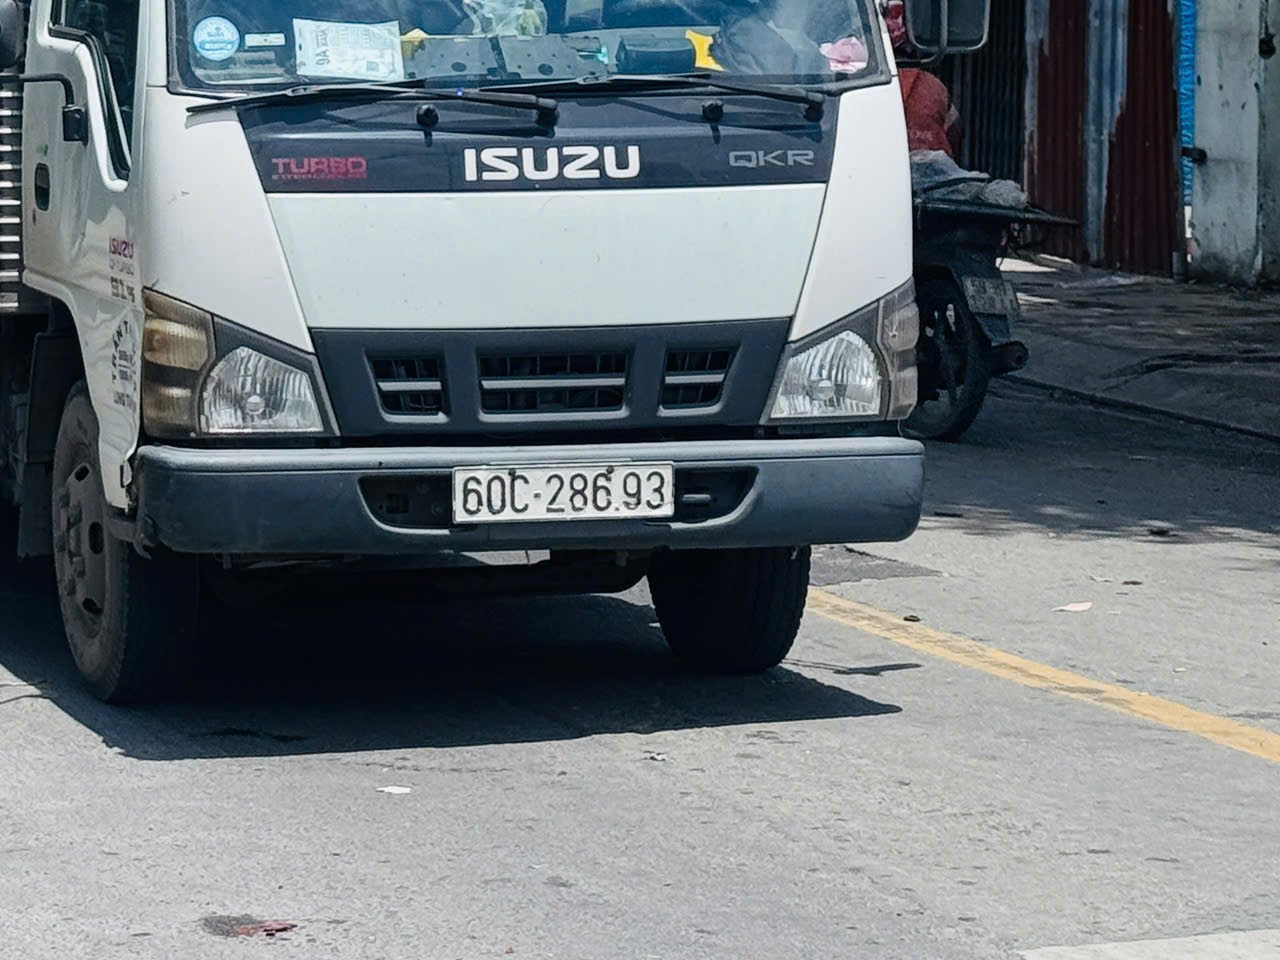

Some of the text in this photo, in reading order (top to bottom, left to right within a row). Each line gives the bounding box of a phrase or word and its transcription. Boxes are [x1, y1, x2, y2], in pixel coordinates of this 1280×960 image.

[271, 156, 368, 174] TURBO
[463, 145, 641, 182] ISUZU
[728, 150, 815, 168] QKR
[461, 470, 667, 517] 60C-286.93
